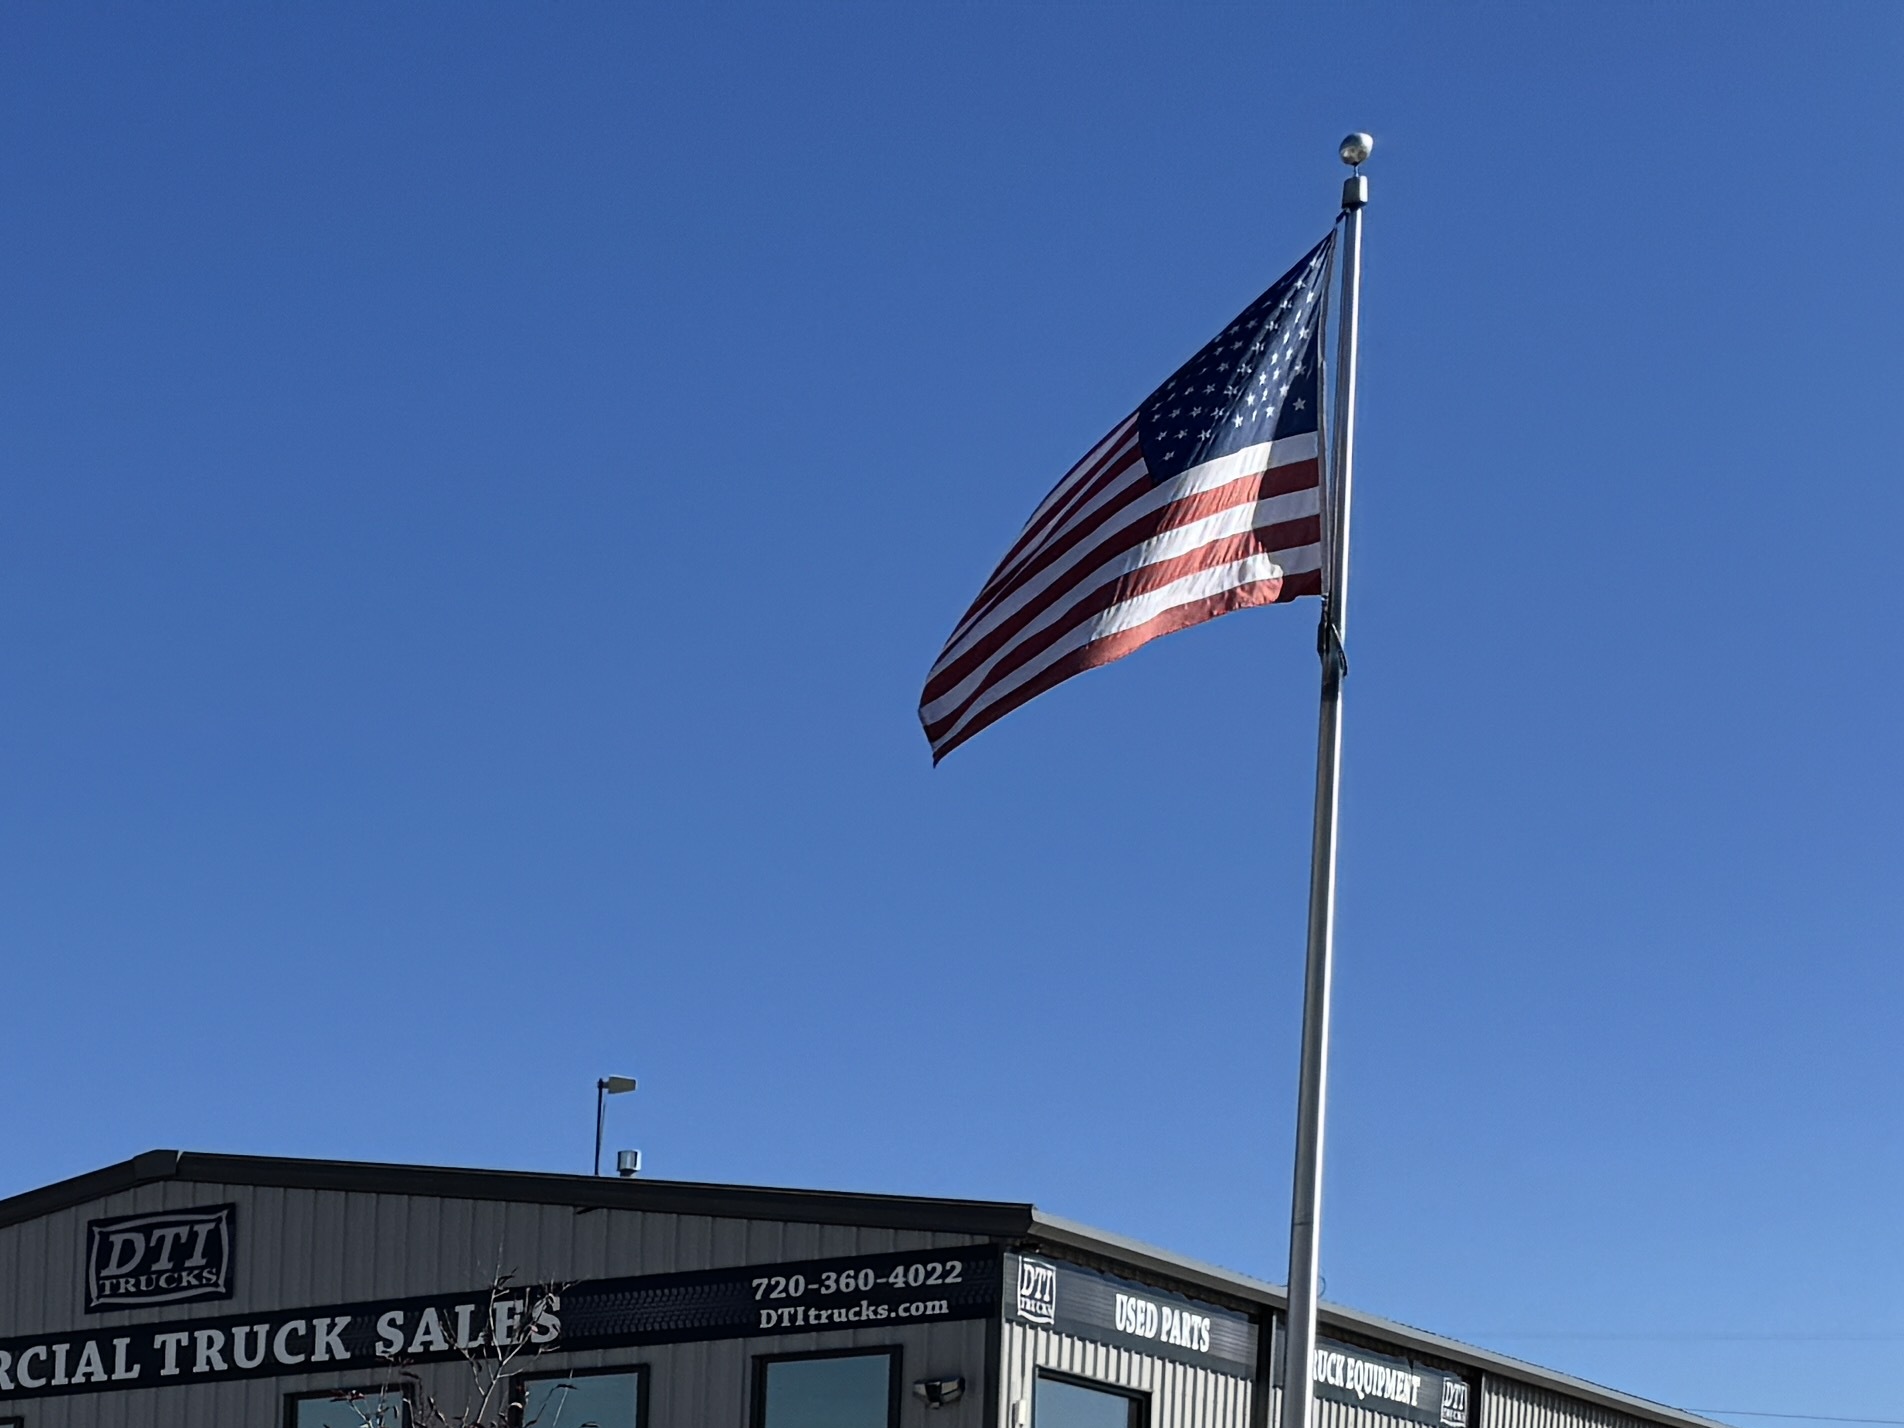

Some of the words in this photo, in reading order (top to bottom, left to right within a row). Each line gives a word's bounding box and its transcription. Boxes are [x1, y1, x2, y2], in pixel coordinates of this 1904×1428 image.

[100, 1221, 218, 1278] DTI
[98, 1268, 217, 1295] TRUCKS
[751, 1260, 963, 1301] 720-360-4022
[1020, 1263, 1054, 1302] DTI
[153, 1311, 351, 1377] TRUCK
[374, 1296, 562, 1357] SALES
[759, 1300, 949, 1329] DTItrucks.com
[1115, 1293, 1158, 1339] USED
[1160, 1306, 1210, 1353] PARTS
[1312, 1349, 1344, 1388] RUCK
[1346, 1357, 1421, 1406] EQUIPMENT
